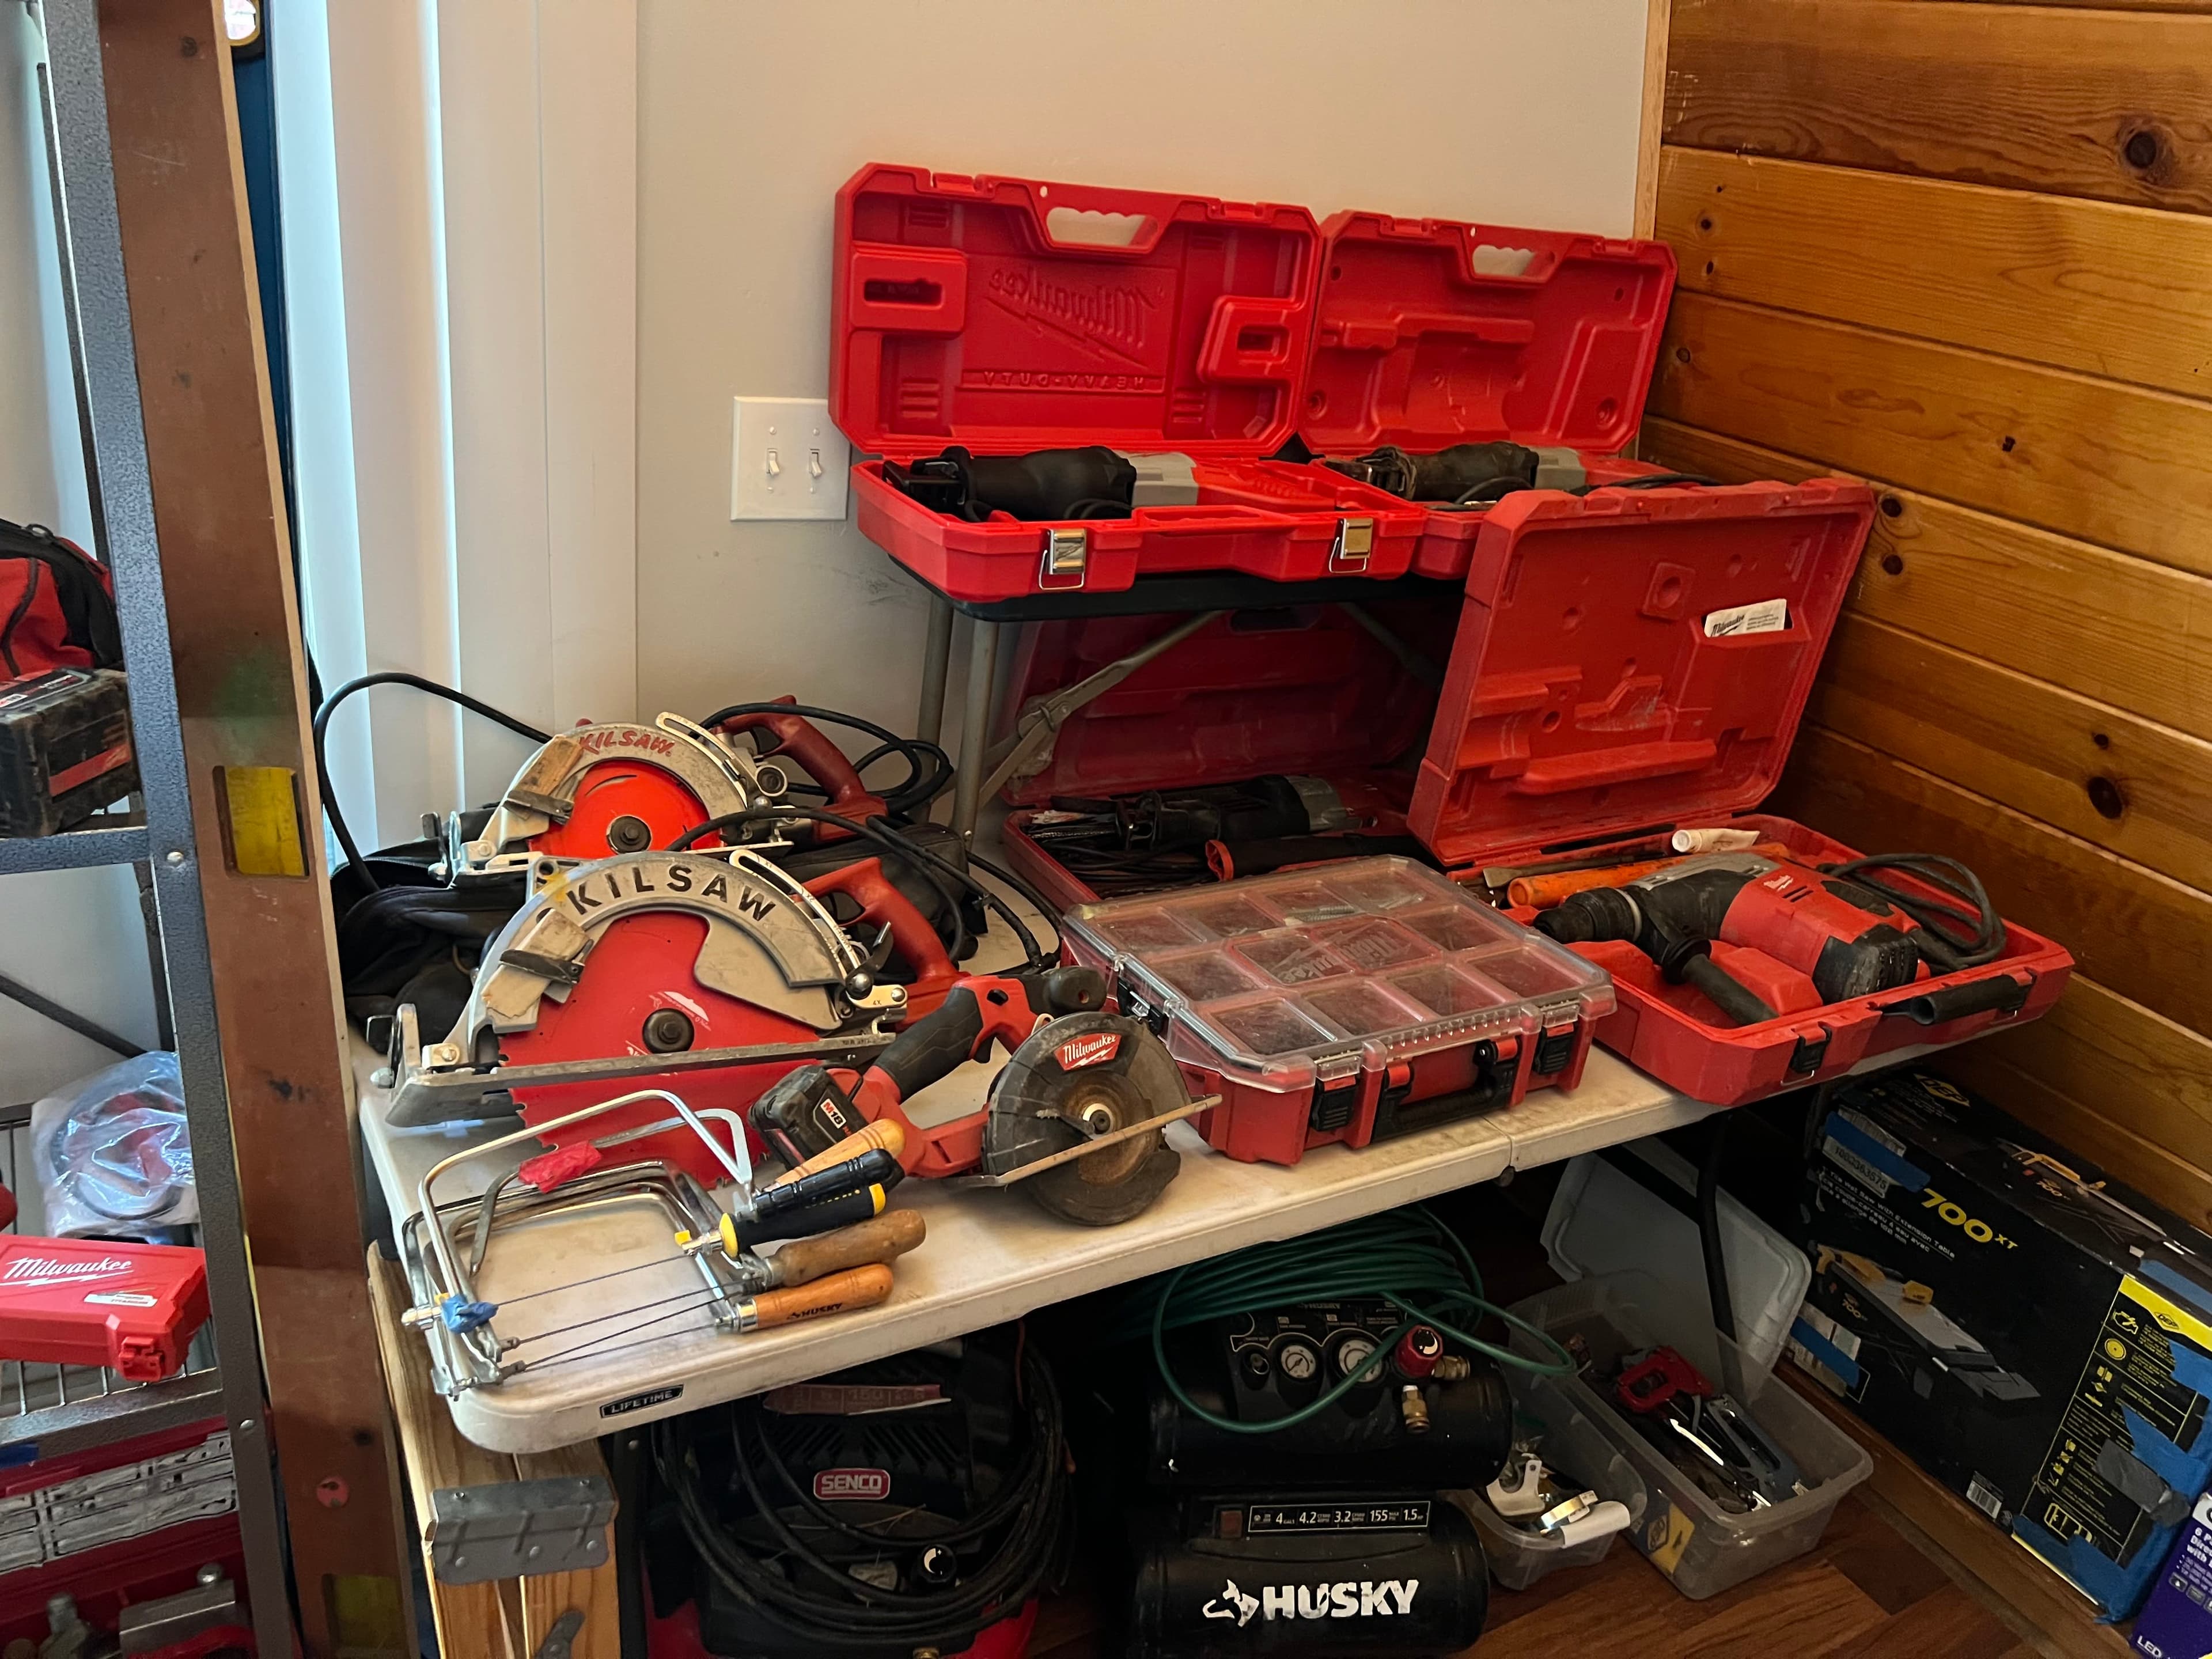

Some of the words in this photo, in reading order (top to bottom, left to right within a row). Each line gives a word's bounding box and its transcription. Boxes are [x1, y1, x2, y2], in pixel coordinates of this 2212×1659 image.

[1063, 1035, 1116, 1064] Milwaukee
[824, 1102, 843, 1124] M18
[1921, 1188, 1993, 1244] 700
[5, 1257, 132, 1279] Milwaukee
[612, 1391, 673, 1413] LIFETIME
[821, 1475, 881, 1491] SENCO
[1275, 1512, 1283, 1525] 4
[1300, 1512, 1317, 1524] 4.2
[1334, 1511, 1351, 1522] 3.2
[1370, 1509, 1388, 1521] 155
[1403, 1509, 1418, 1521] 1.5
[1263, 1580, 1419, 1620] HUSKY
[2137, 1635, 2162, 1658] LED
